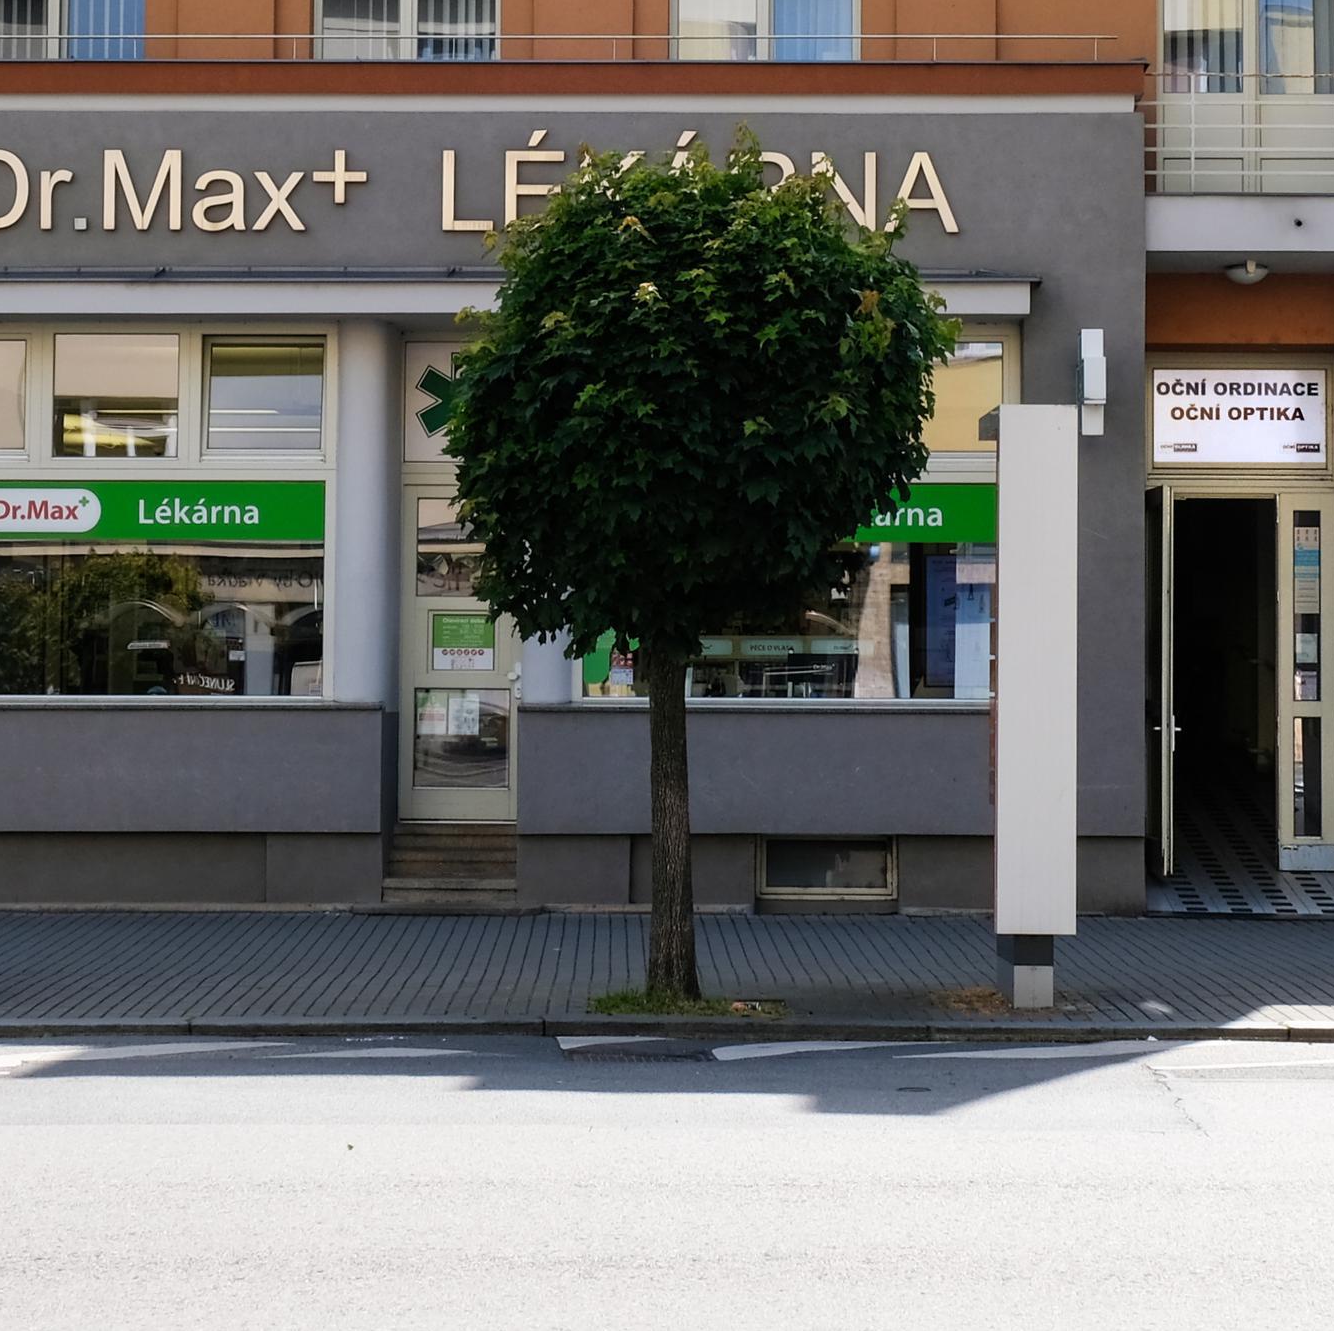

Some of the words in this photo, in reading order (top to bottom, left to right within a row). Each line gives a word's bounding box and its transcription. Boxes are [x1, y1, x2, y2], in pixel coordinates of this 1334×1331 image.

[1156, 378, 1207, 396] OČNÍ
[1213, 381, 1319, 397] ORDINACE
[1170, 403, 1221, 421] OČNÍ
[1227, 406, 1306, 422] OPTIKA
[138, 497, 260, 525] Lékárna
